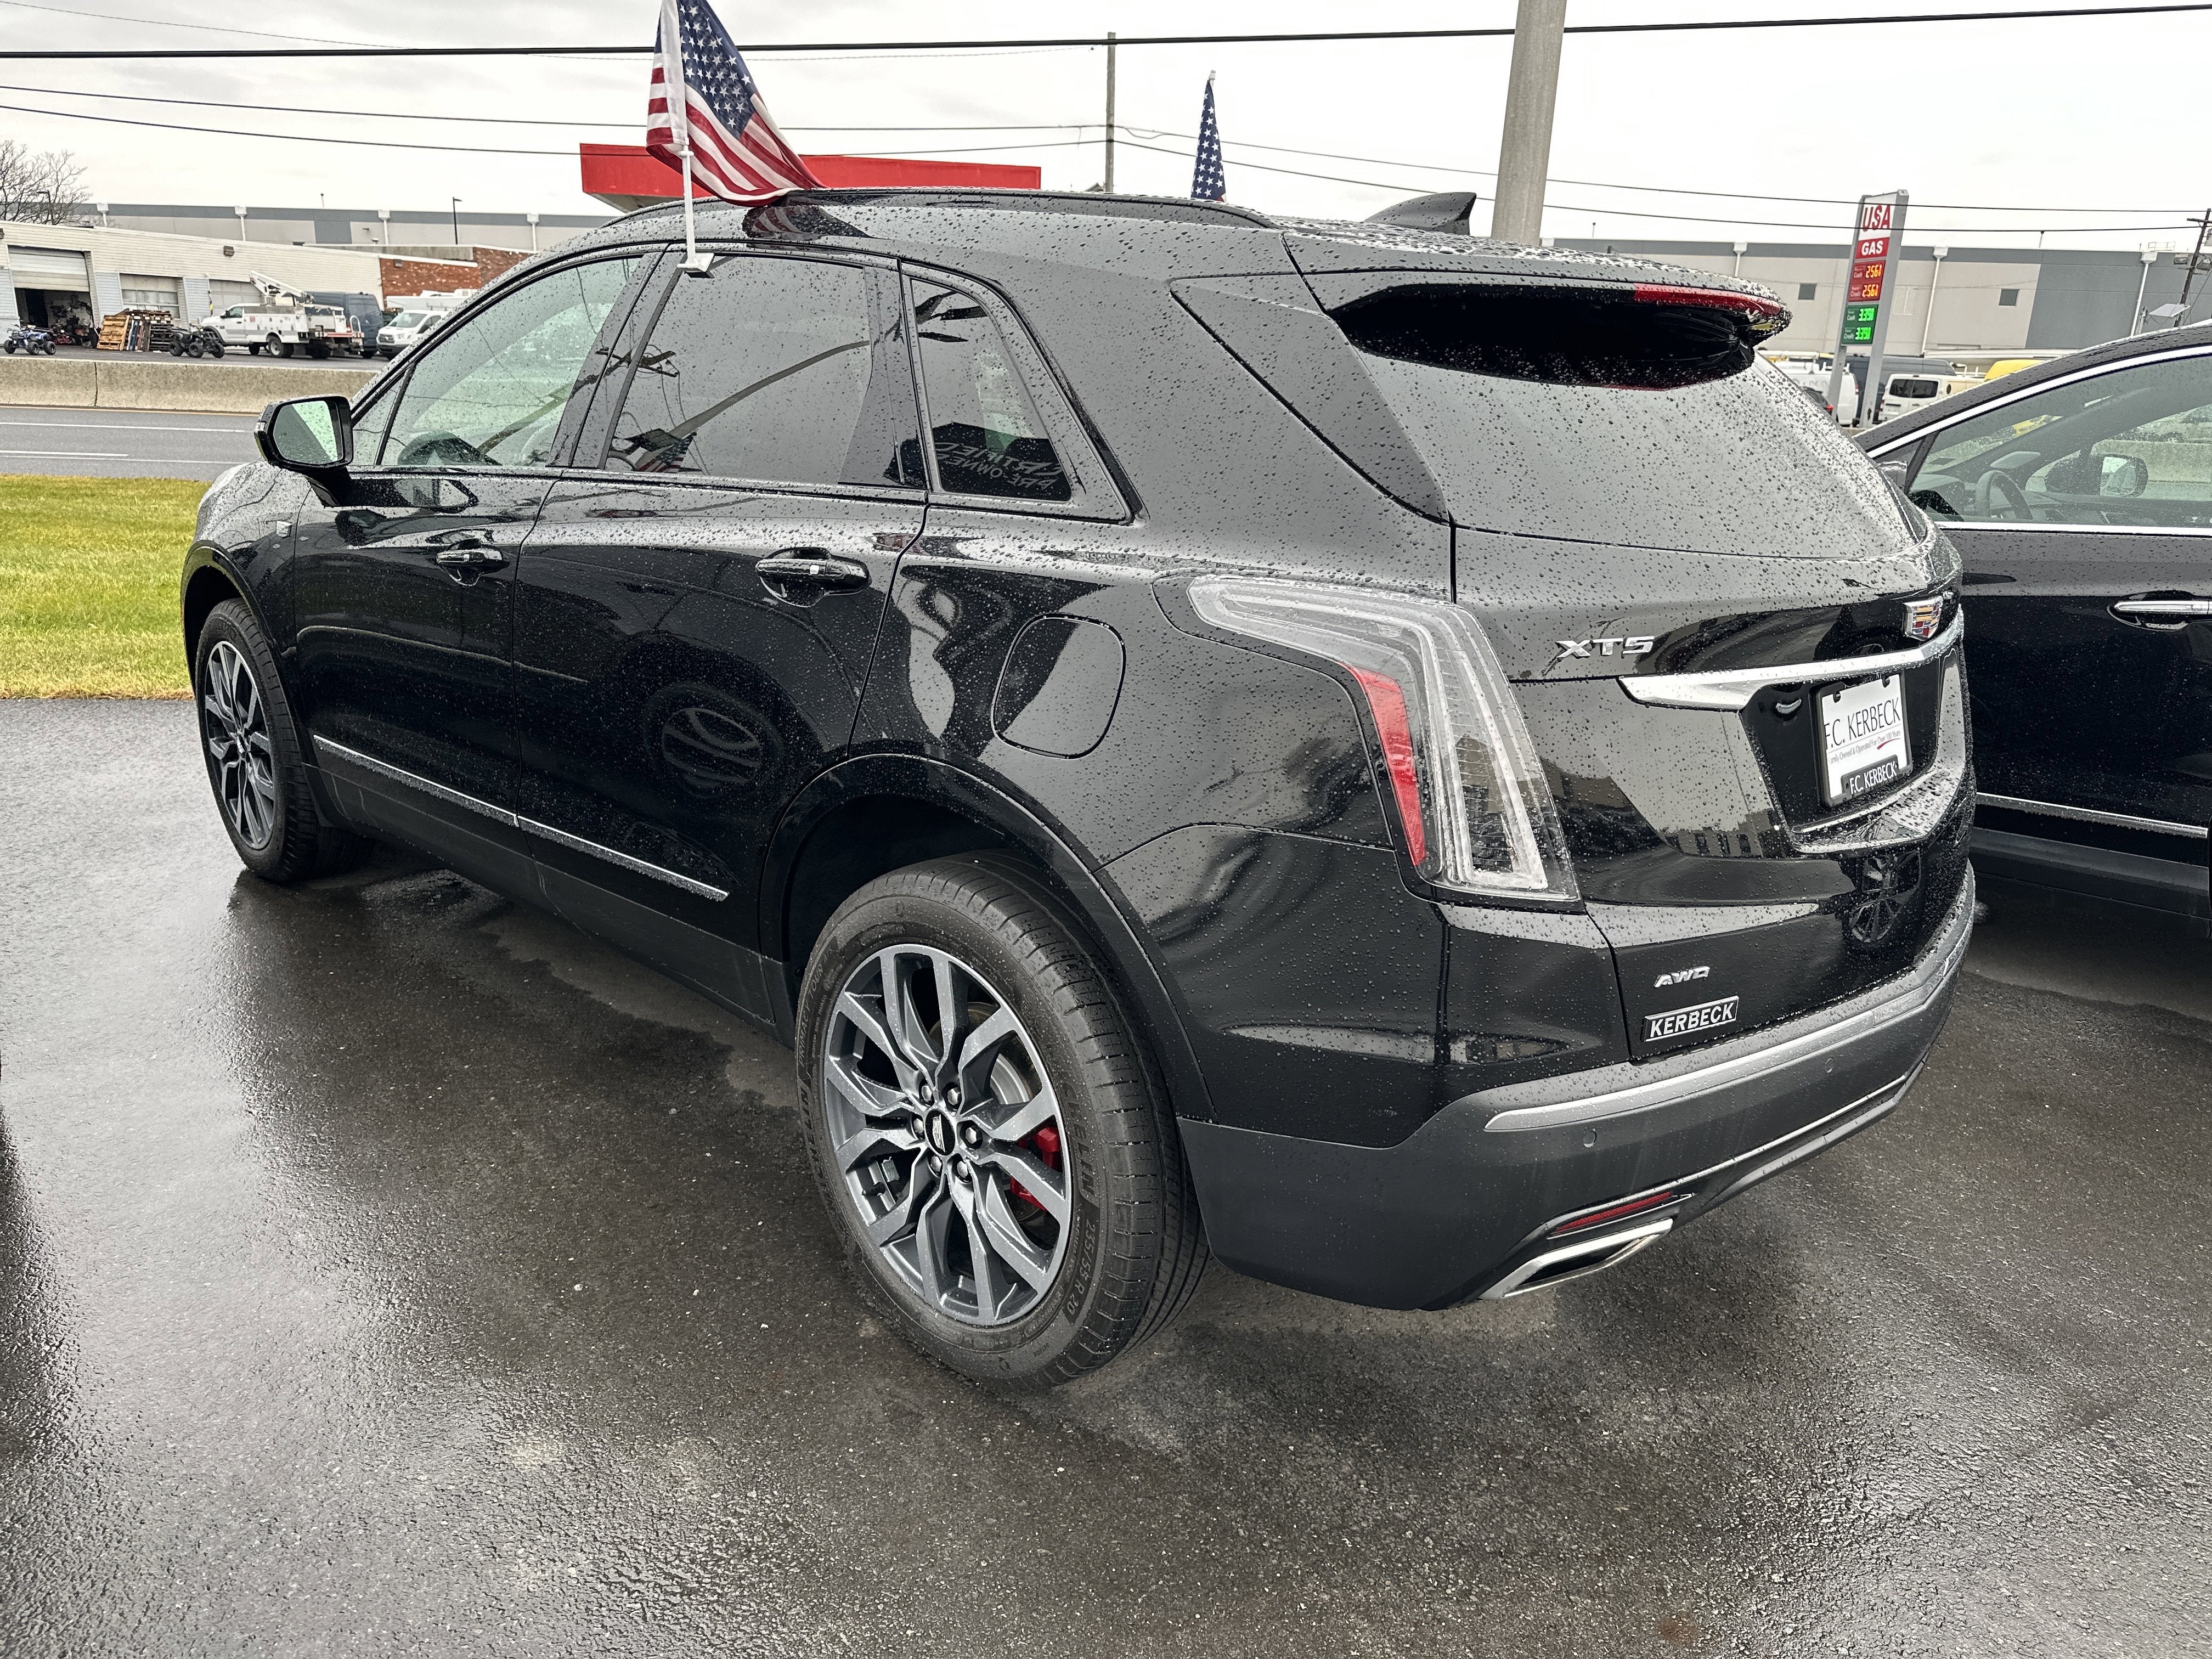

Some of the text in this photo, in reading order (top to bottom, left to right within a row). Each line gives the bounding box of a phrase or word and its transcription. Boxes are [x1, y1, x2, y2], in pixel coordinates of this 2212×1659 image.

[1862, 205, 1892, 232] USA
[1861, 241, 1883, 256] GAS
[1555, 636, 1655, 658] XT5
[1824, 697, 1901, 750] F.C. KERBECK
[1839, 749, 1852, 760] Owned
[1856, 741, 1871, 754] Operated
[1849, 761, 1897, 794] F.C. KERBECK
[1654, 966, 1711, 988] AWD
[798, 1000, 810, 1067] PRIMACY
[808, 963, 823, 998] TOUR
[1650, 1002, 1734, 1032] KERBECK
[1075, 1279, 1085, 1295] R
[1067, 1293, 1079, 1315] 20
